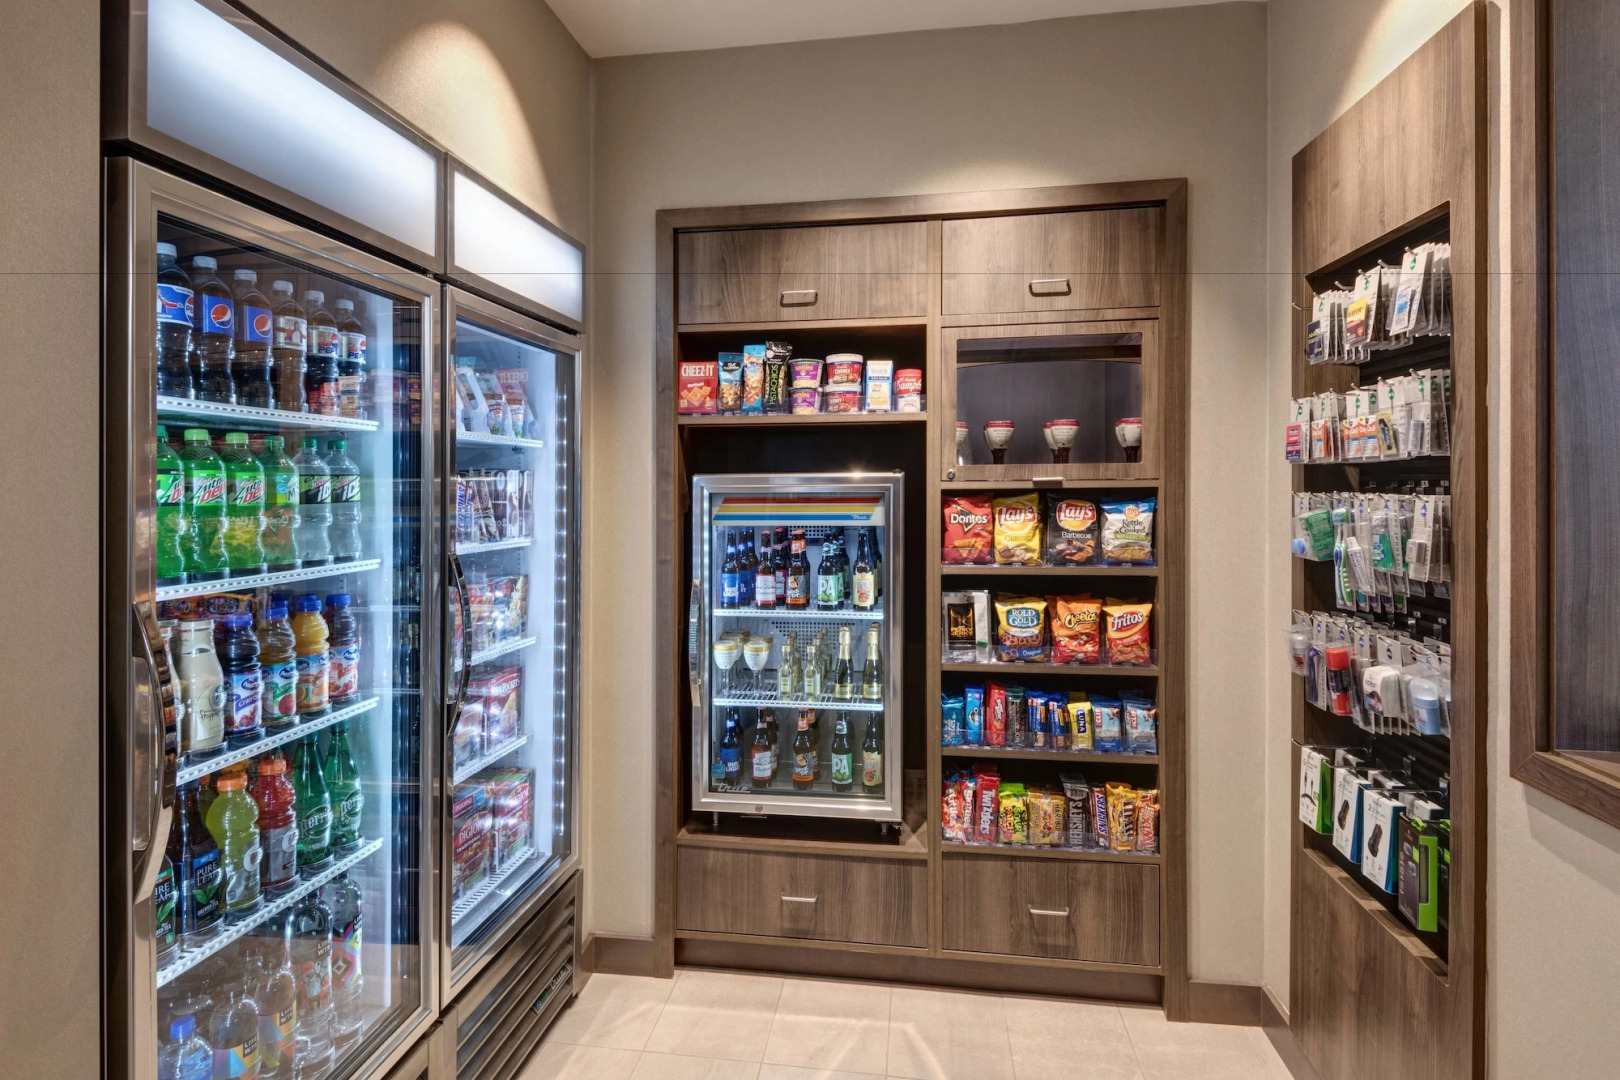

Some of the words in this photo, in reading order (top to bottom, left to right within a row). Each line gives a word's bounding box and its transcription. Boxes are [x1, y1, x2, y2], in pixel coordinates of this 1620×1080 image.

[769, 364, 779, 405] PISTACHIOS
[950, 513, 988, 524] Doritos
[999, 507, 1034, 525] Lay's
[1059, 503, 1094, 521] Lay's
[1121, 519, 1144, 528] Kettle
[1061, 531, 1092, 539] Barbecue
[1009, 616, 1038, 627] GOLD
[1012, 609, 1035, 617] ROLD
[1064, 610, 1098, 631] Cheetos
[1111, 612, 1144, 631] Fritos
[1077, 710, 1086, 733] LUNA
[1096, 794, 1108, 836] SNICKERS
[1142, 815, 1156, 849] TWIX
[196, 860, 219, 876] PURE
